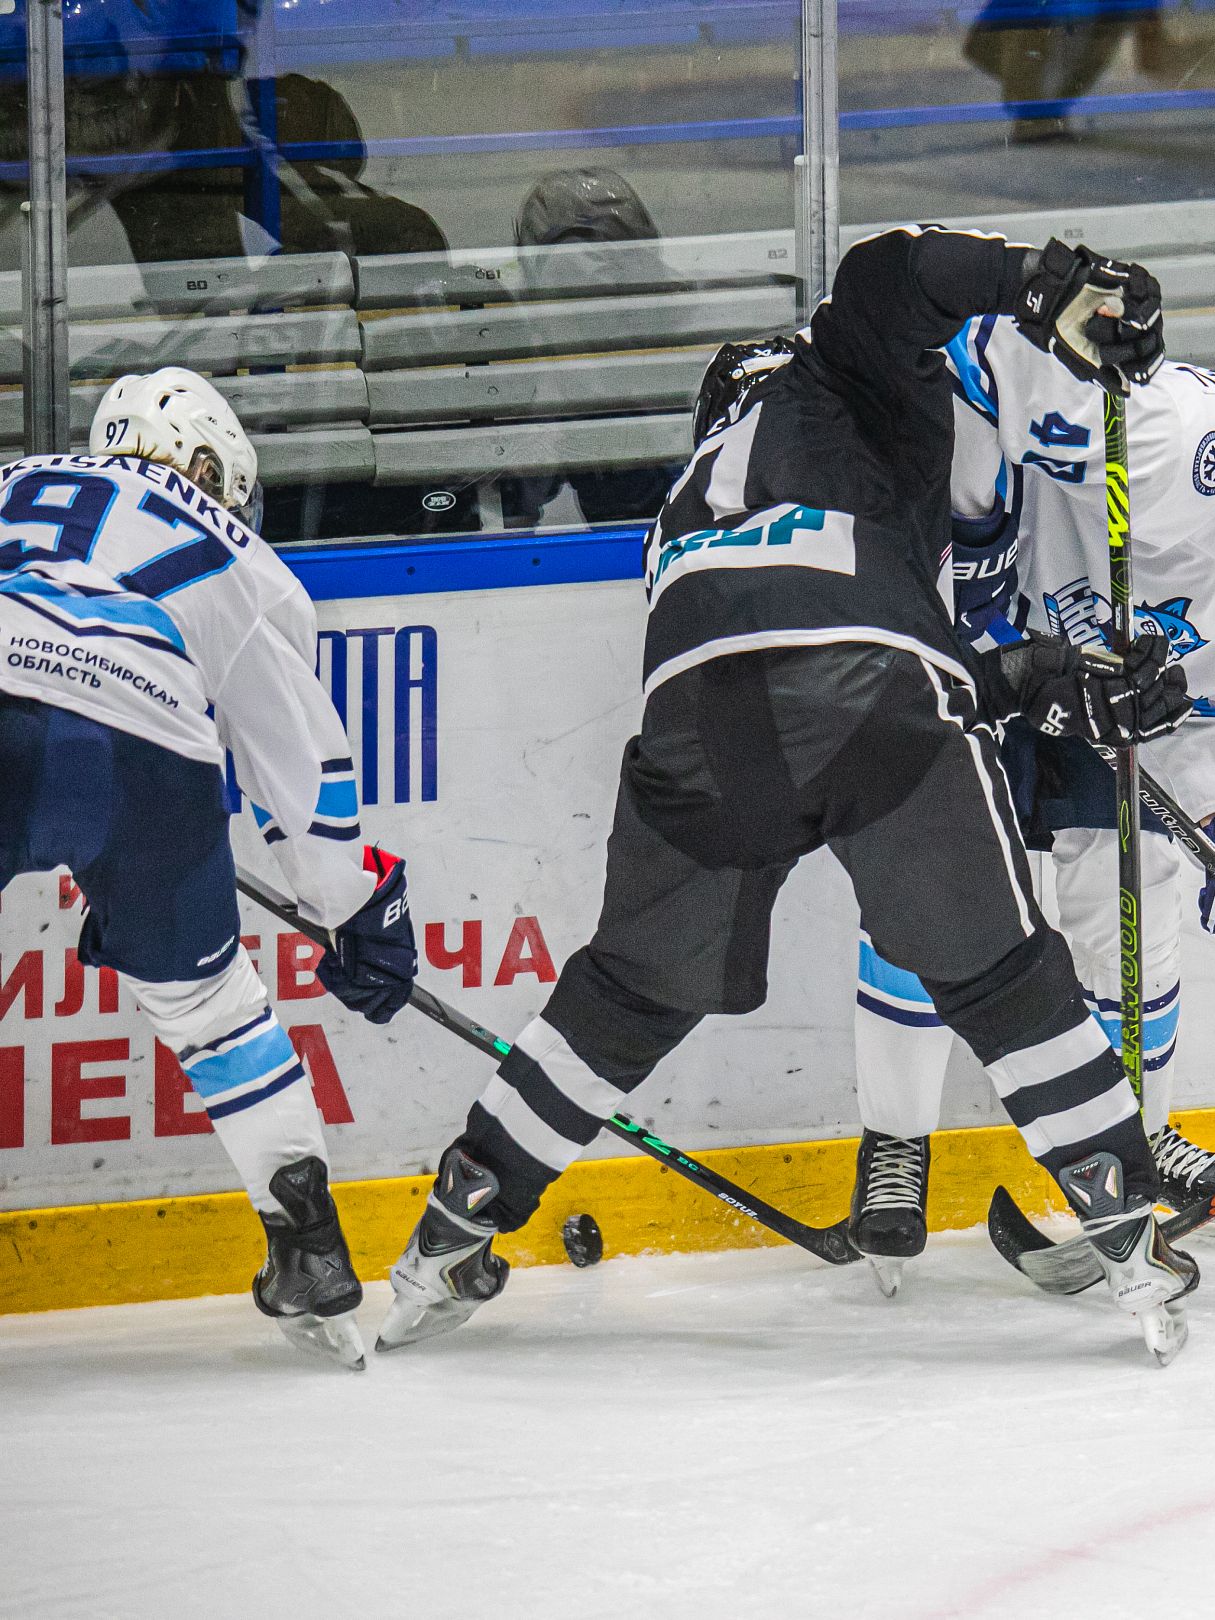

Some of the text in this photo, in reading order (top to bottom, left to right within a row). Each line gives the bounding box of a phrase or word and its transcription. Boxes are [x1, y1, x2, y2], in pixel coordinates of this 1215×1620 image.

[105, 418, 130, 449] 97
[0, 469, 237, 600] 97
[7, 653, 102, 689] ОБЛАСТЬ
[10, 636, 179, 709] НОВОСИБИРСКАЯ
[717, 1192, 758, 1219] SOYUZ
